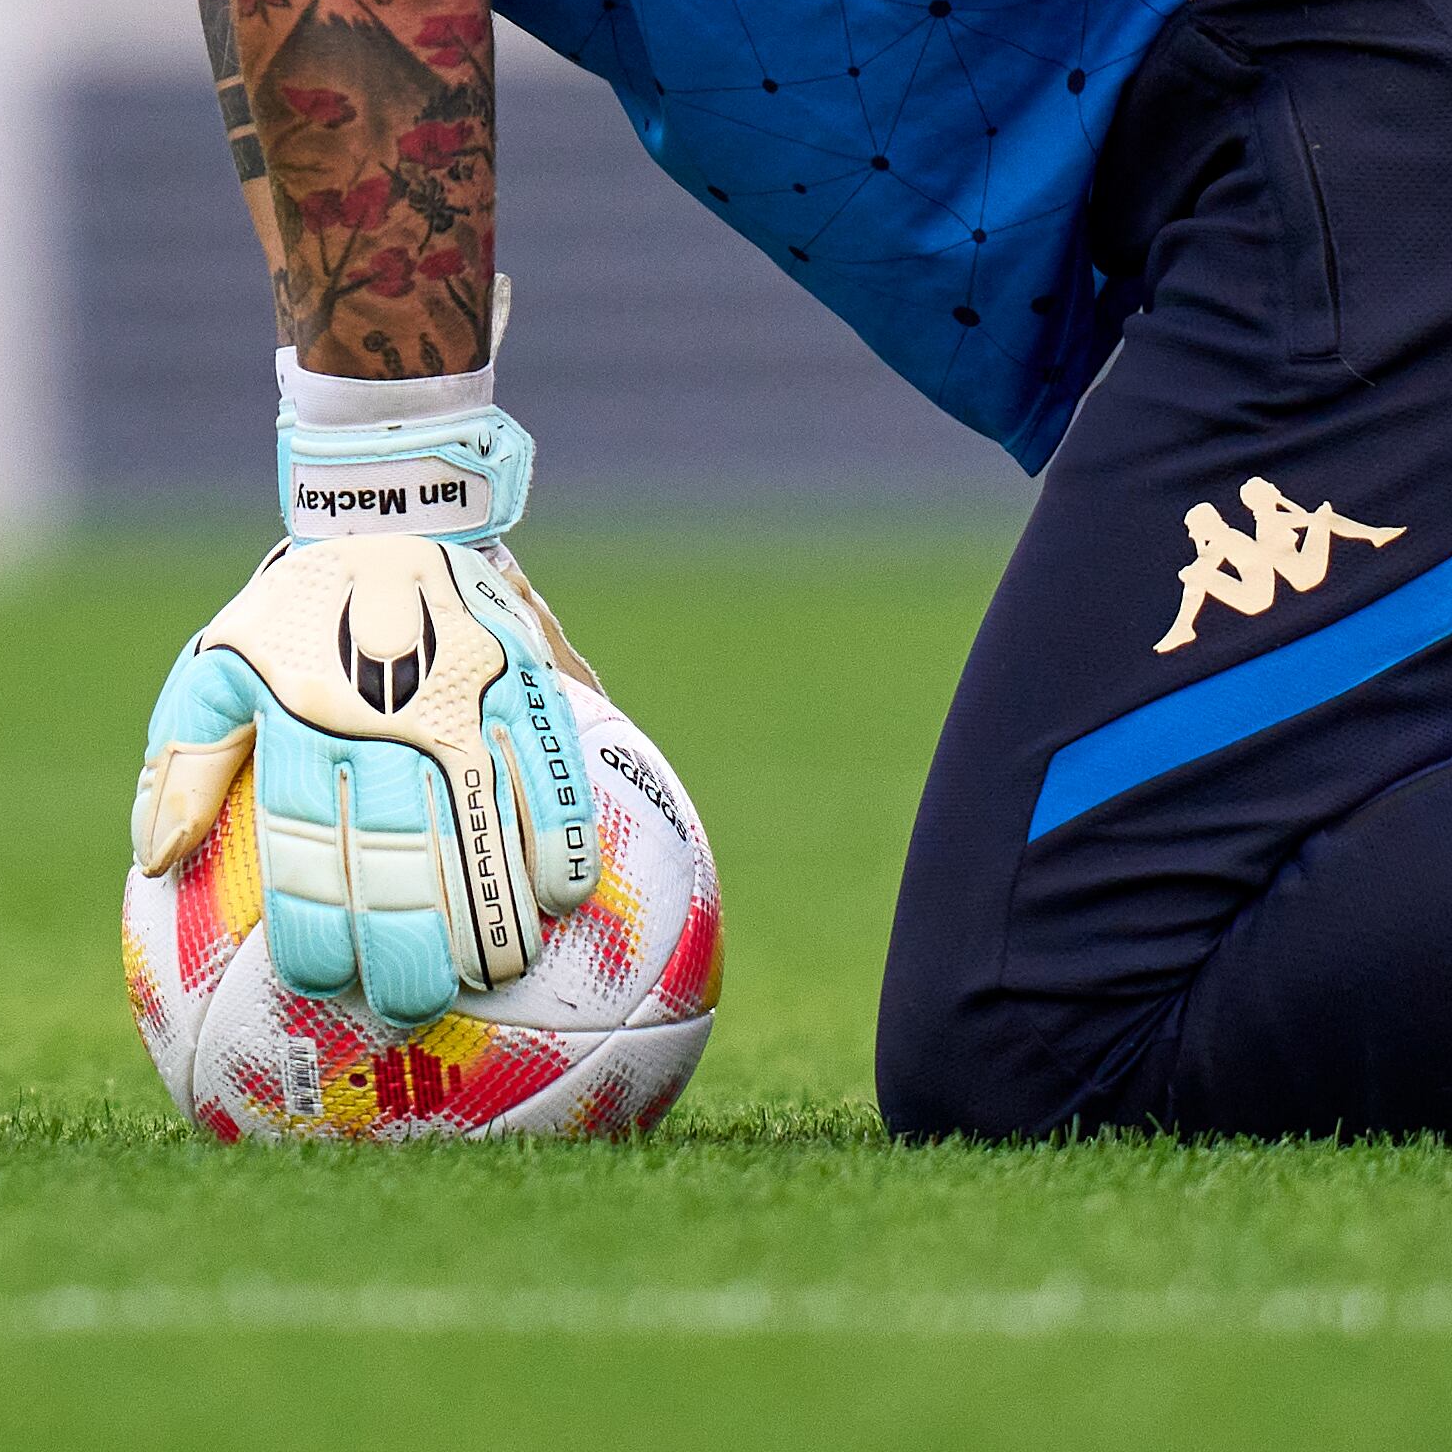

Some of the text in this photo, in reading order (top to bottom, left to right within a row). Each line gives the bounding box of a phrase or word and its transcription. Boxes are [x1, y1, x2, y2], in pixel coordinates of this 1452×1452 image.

[296, 480, 467, 517] Ian Mackay
[521, 670, 587, 882] HO SOCCER
[599, 746, 688, 842] adidas
[464, 768, 507, 949] GUERRERO
